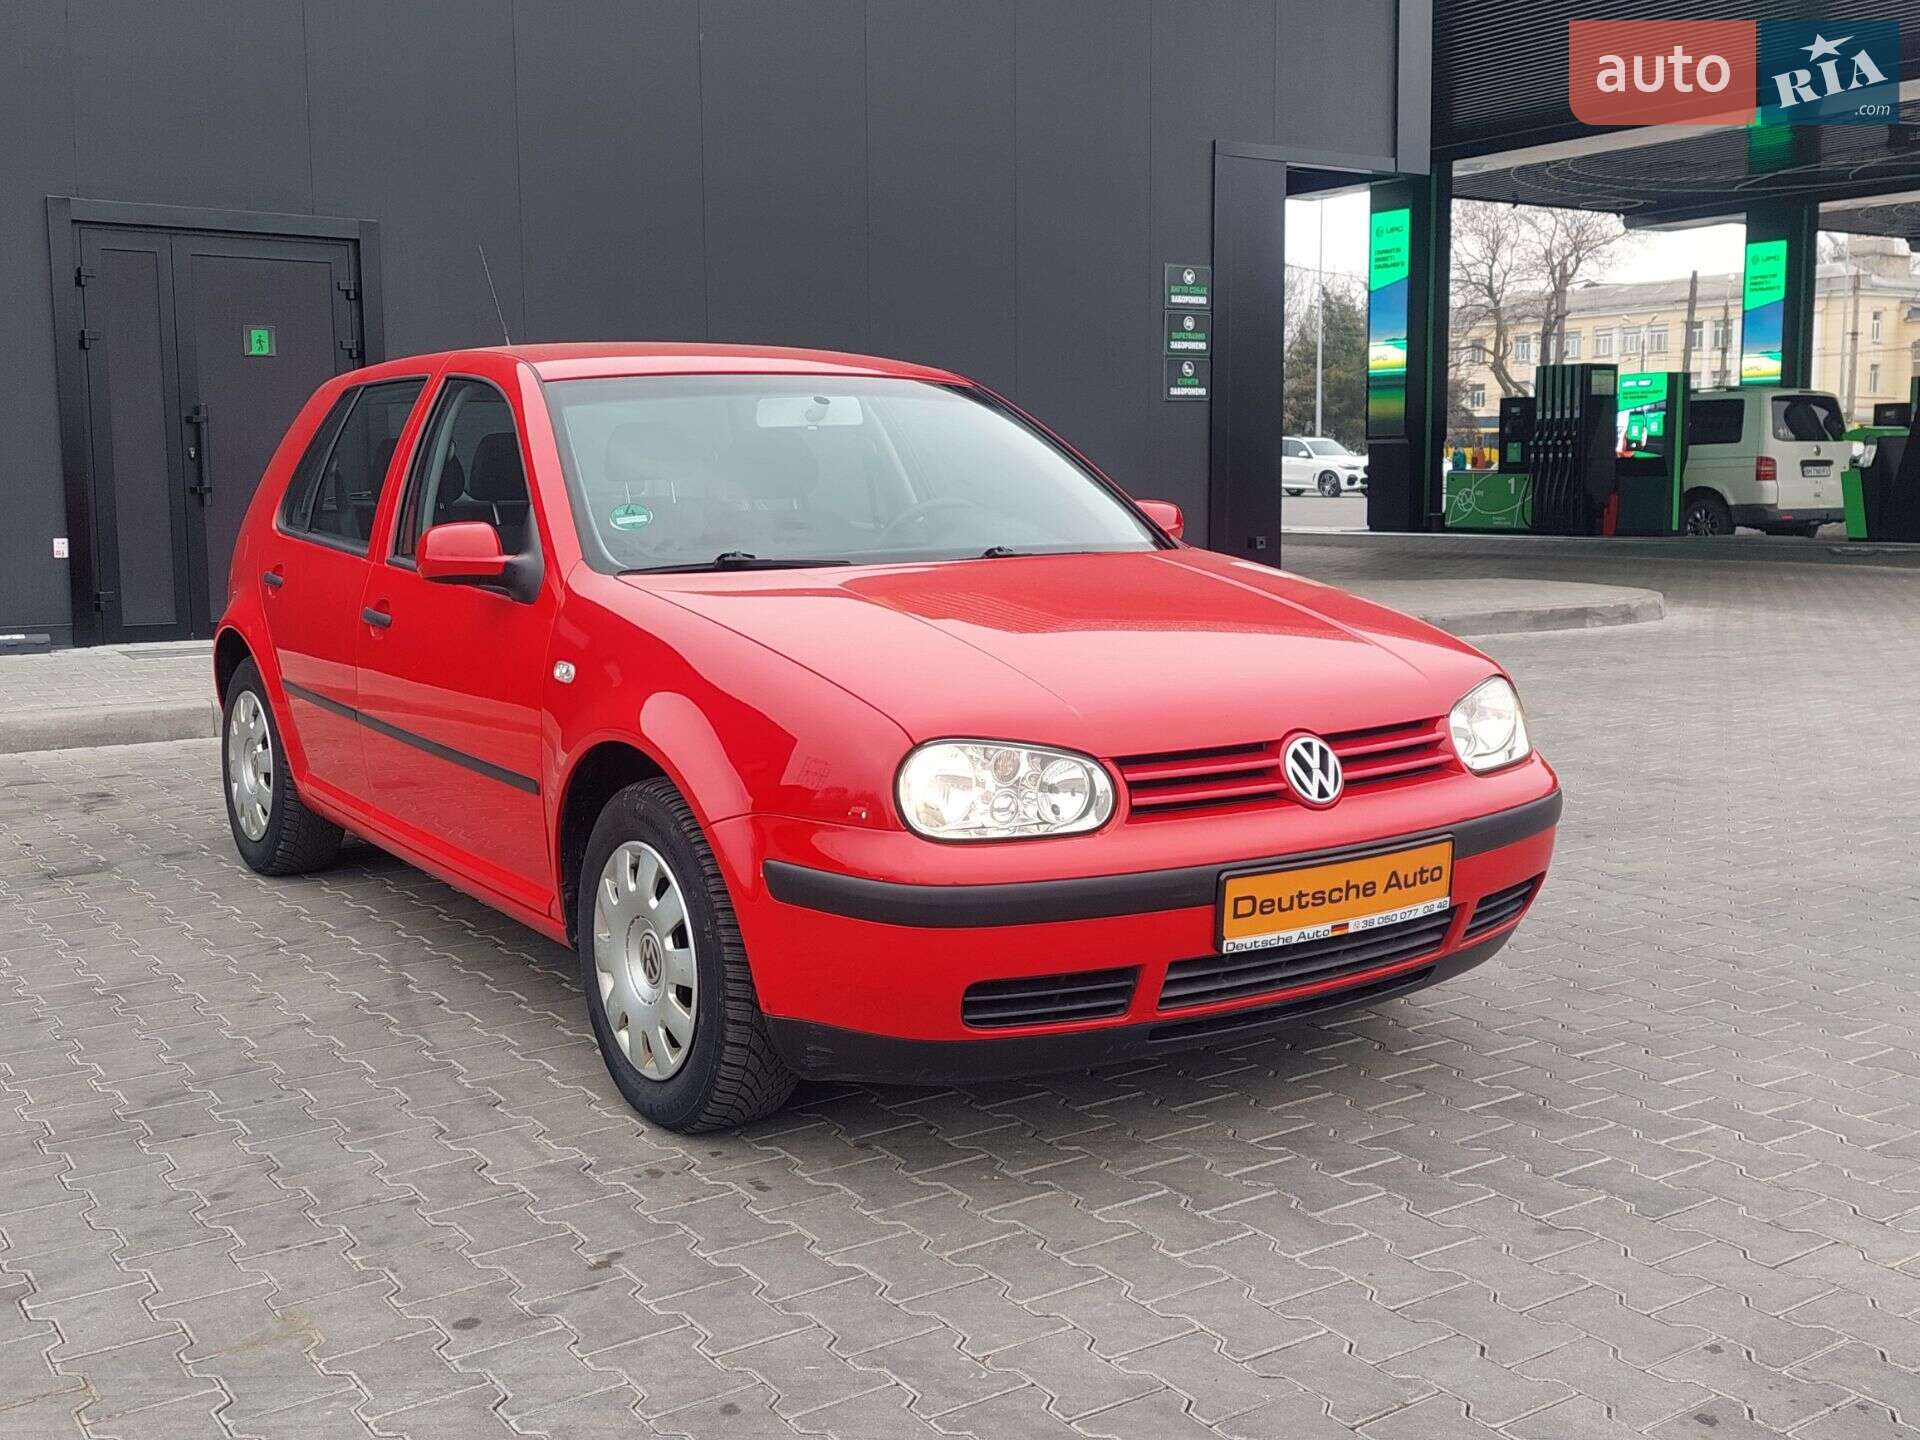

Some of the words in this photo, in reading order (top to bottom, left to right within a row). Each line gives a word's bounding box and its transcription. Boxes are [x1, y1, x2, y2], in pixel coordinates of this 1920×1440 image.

[1507, 477, 1516, 495] 1
[1232, 879, 1377, 919] Deutsche
[1383, 864, 1443, 894] Auto
[1225, 935, 1293, 952] Deutsche
[1296, 928, 1330, 942] Auto
